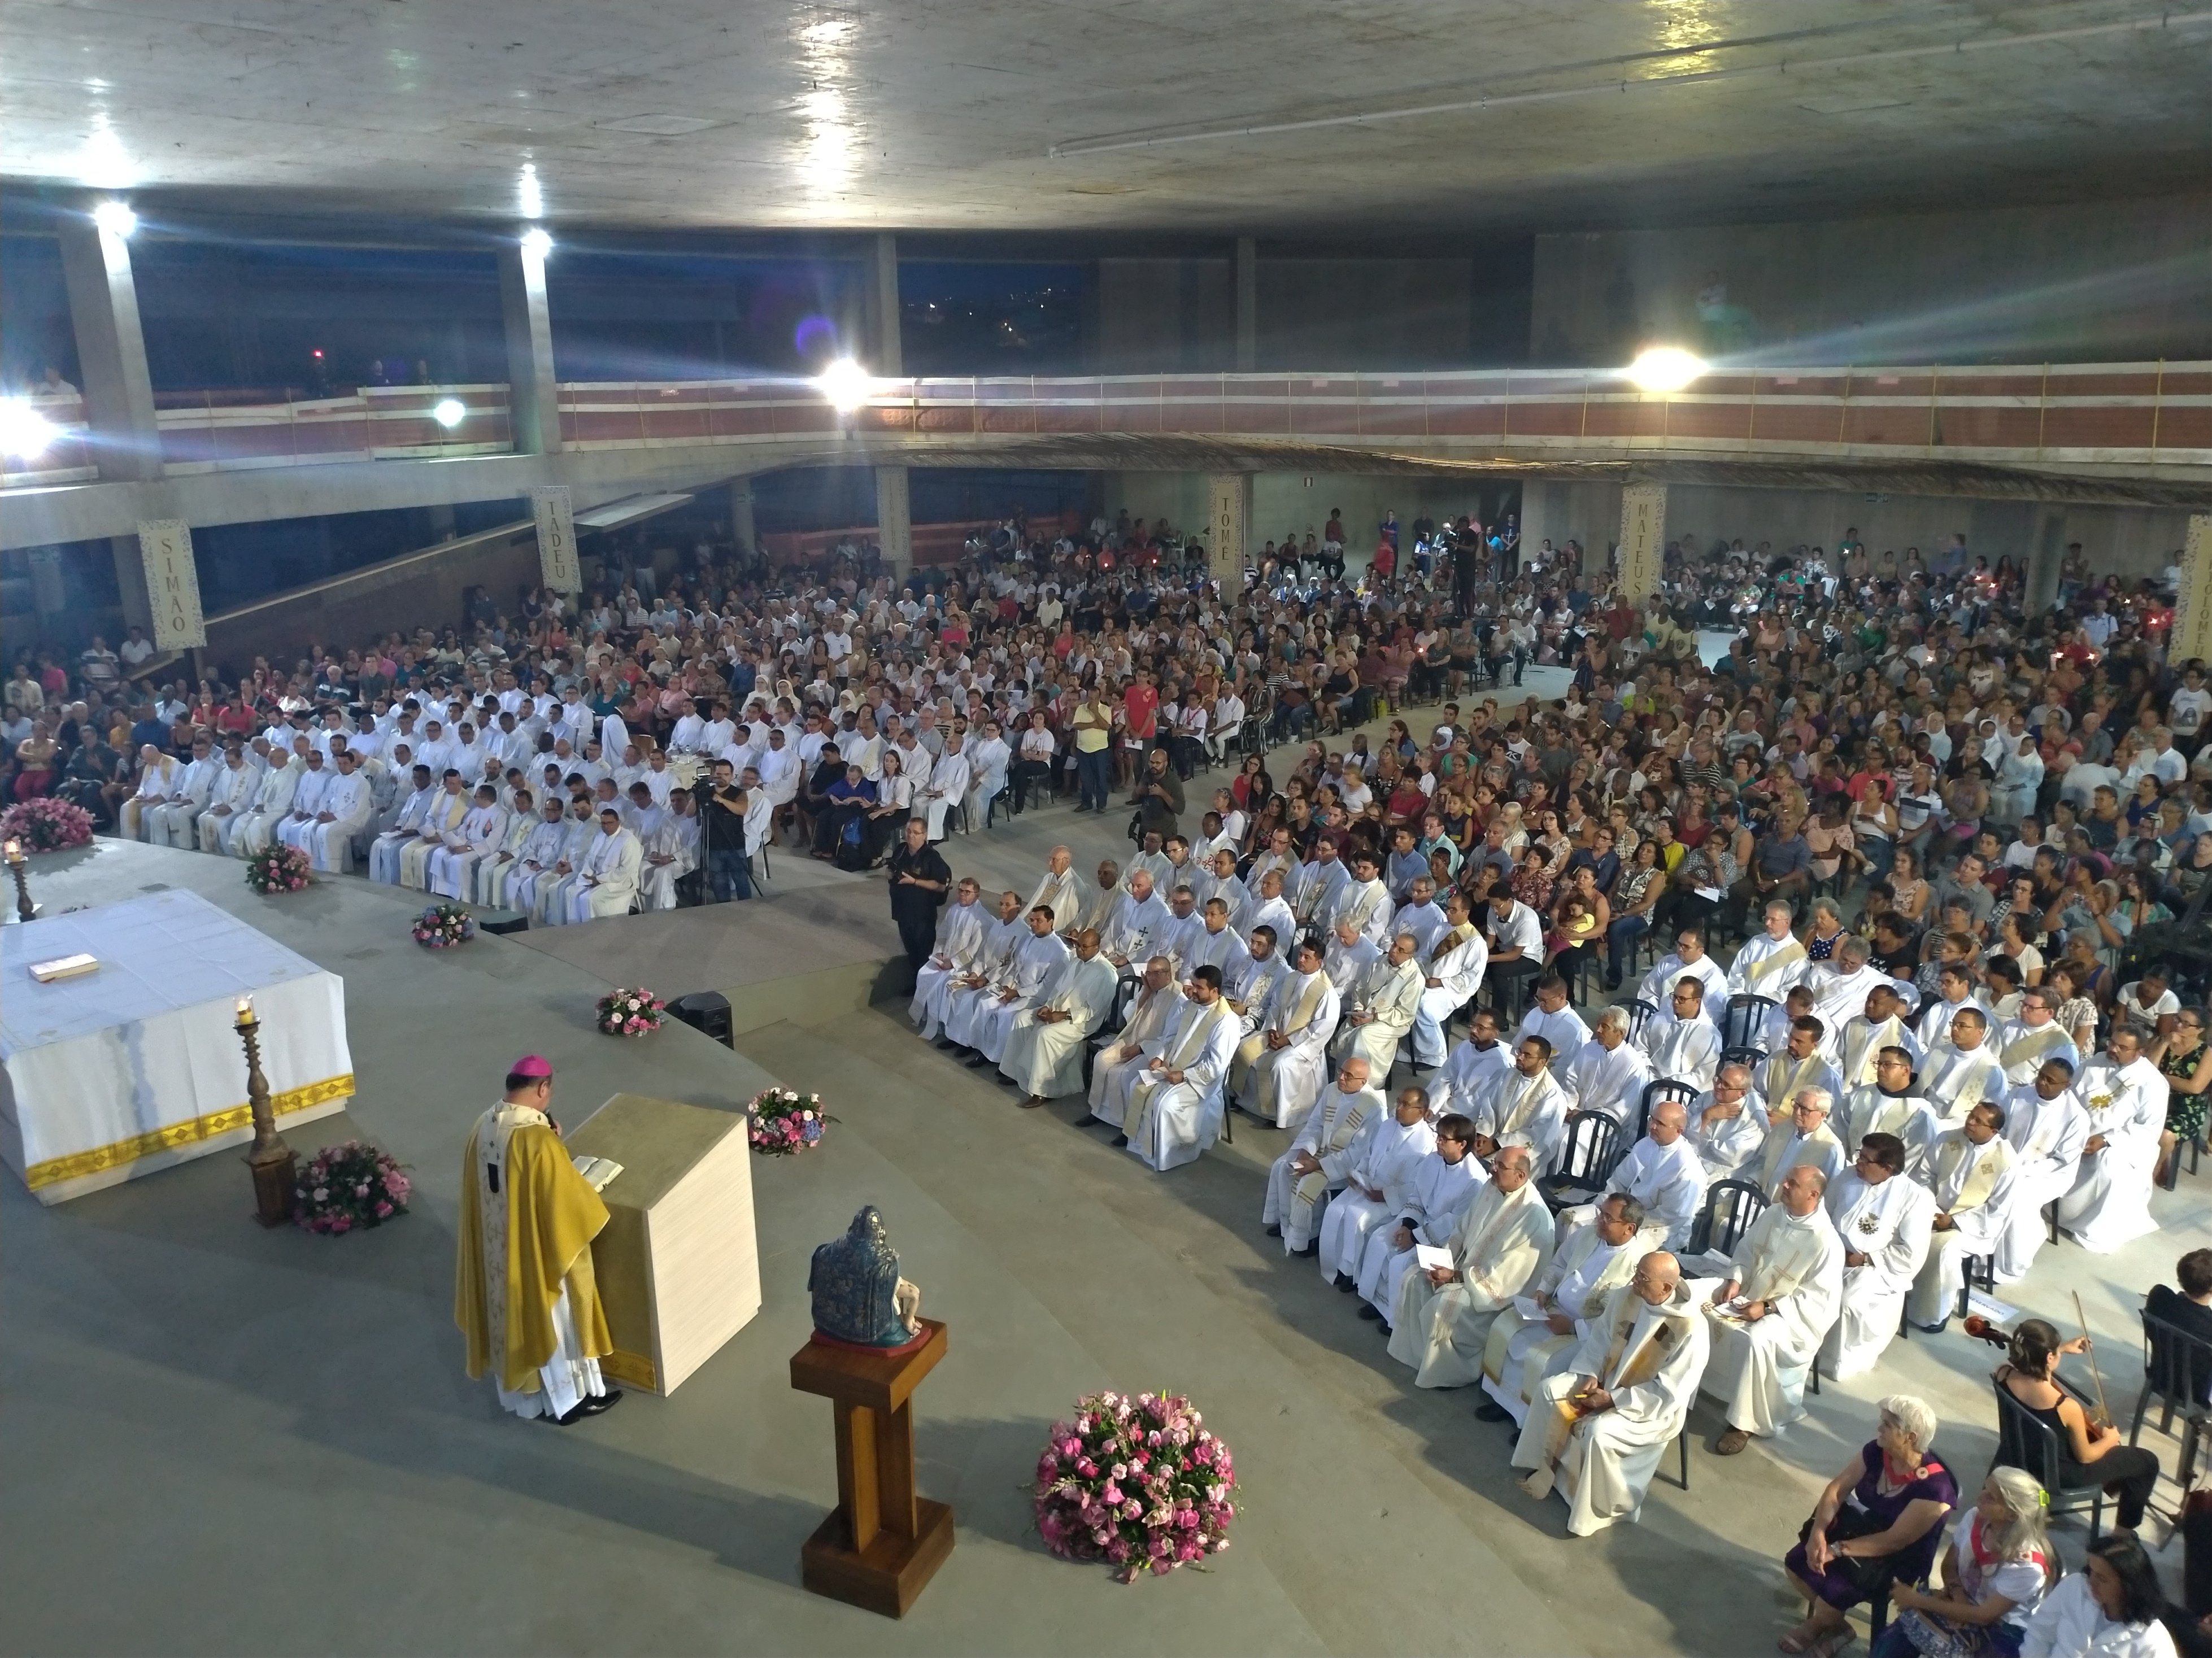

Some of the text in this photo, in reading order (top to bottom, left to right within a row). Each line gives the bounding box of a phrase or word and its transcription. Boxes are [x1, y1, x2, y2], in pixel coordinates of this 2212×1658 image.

[547, 501, 565, 578] TADEU
[1221, 498, 1230, 560] TOMÉ
[1633, 504, 1648, 594] MATEUS
